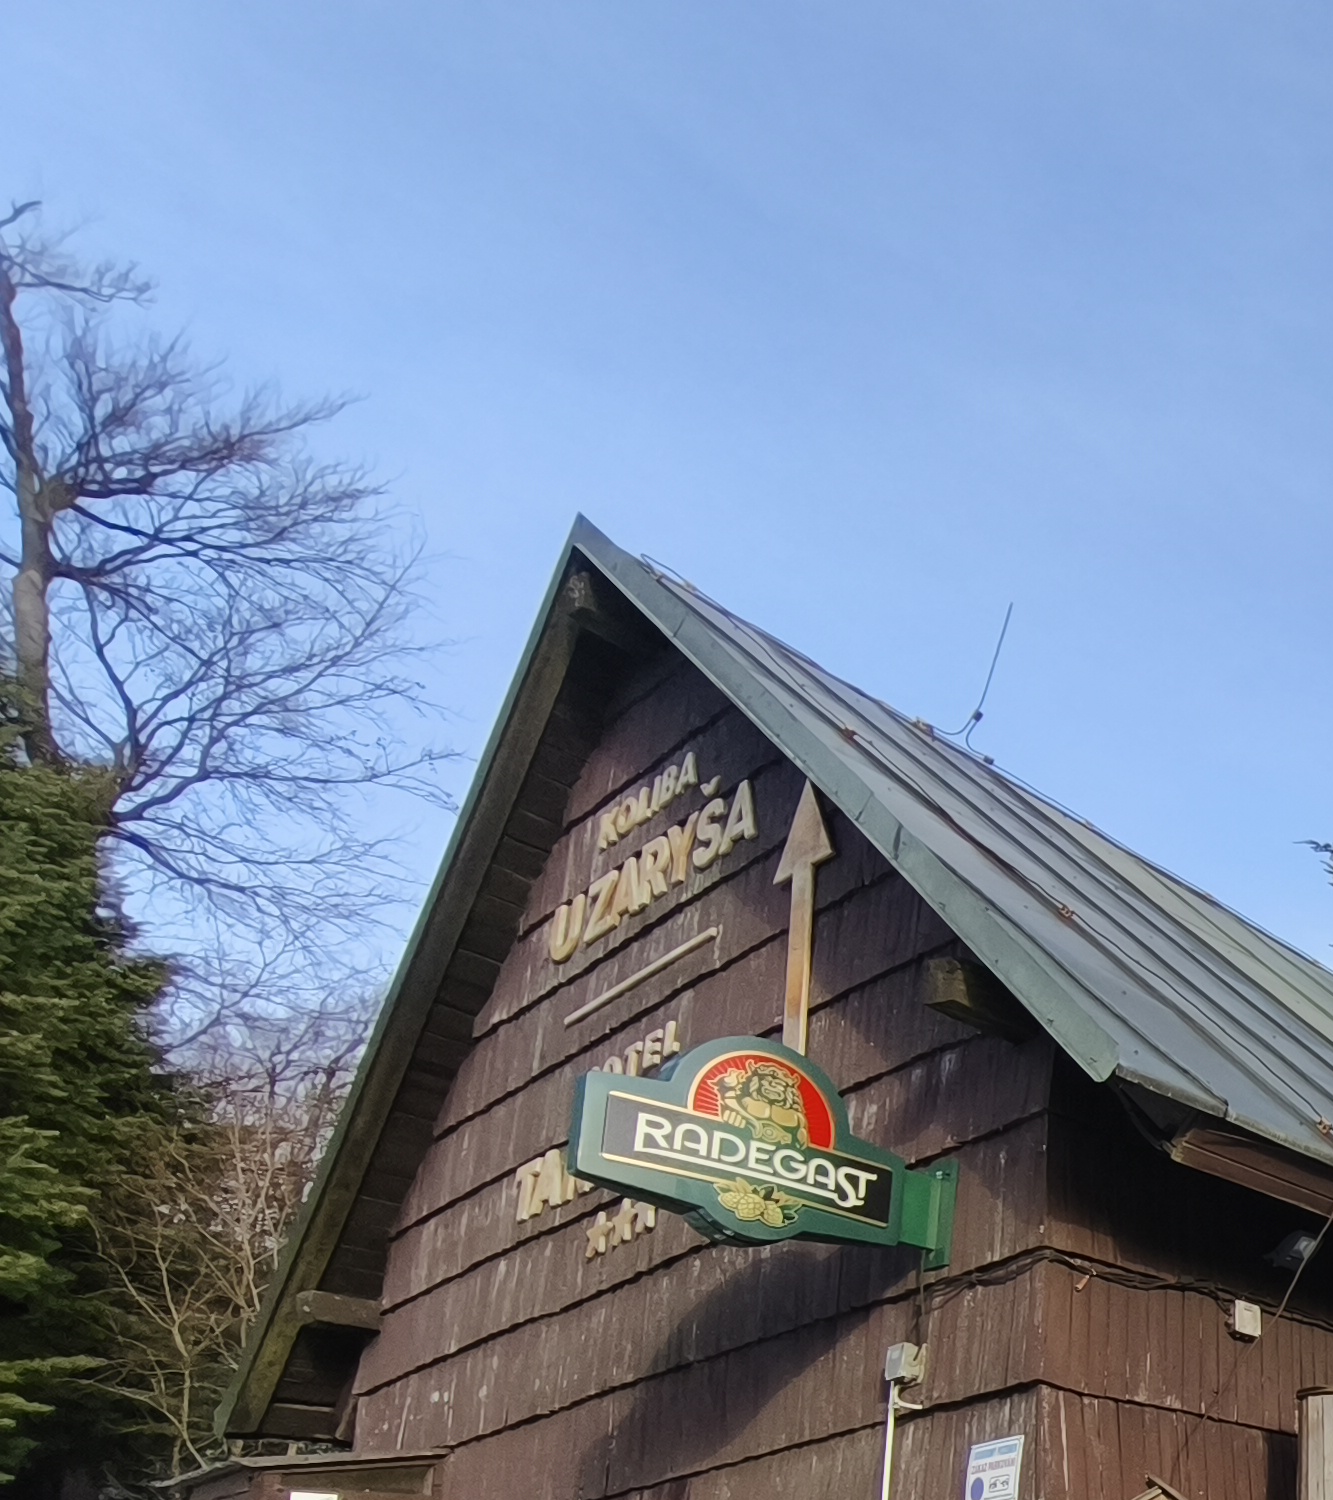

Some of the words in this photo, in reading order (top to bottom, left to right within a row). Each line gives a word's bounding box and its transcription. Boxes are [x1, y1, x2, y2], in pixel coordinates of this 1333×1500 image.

[599, 751, 699, 850] KOLIBA
[591, 1020, 680, 1077] OTEL
[633, 1111, 878, 1208] RADEGAST
